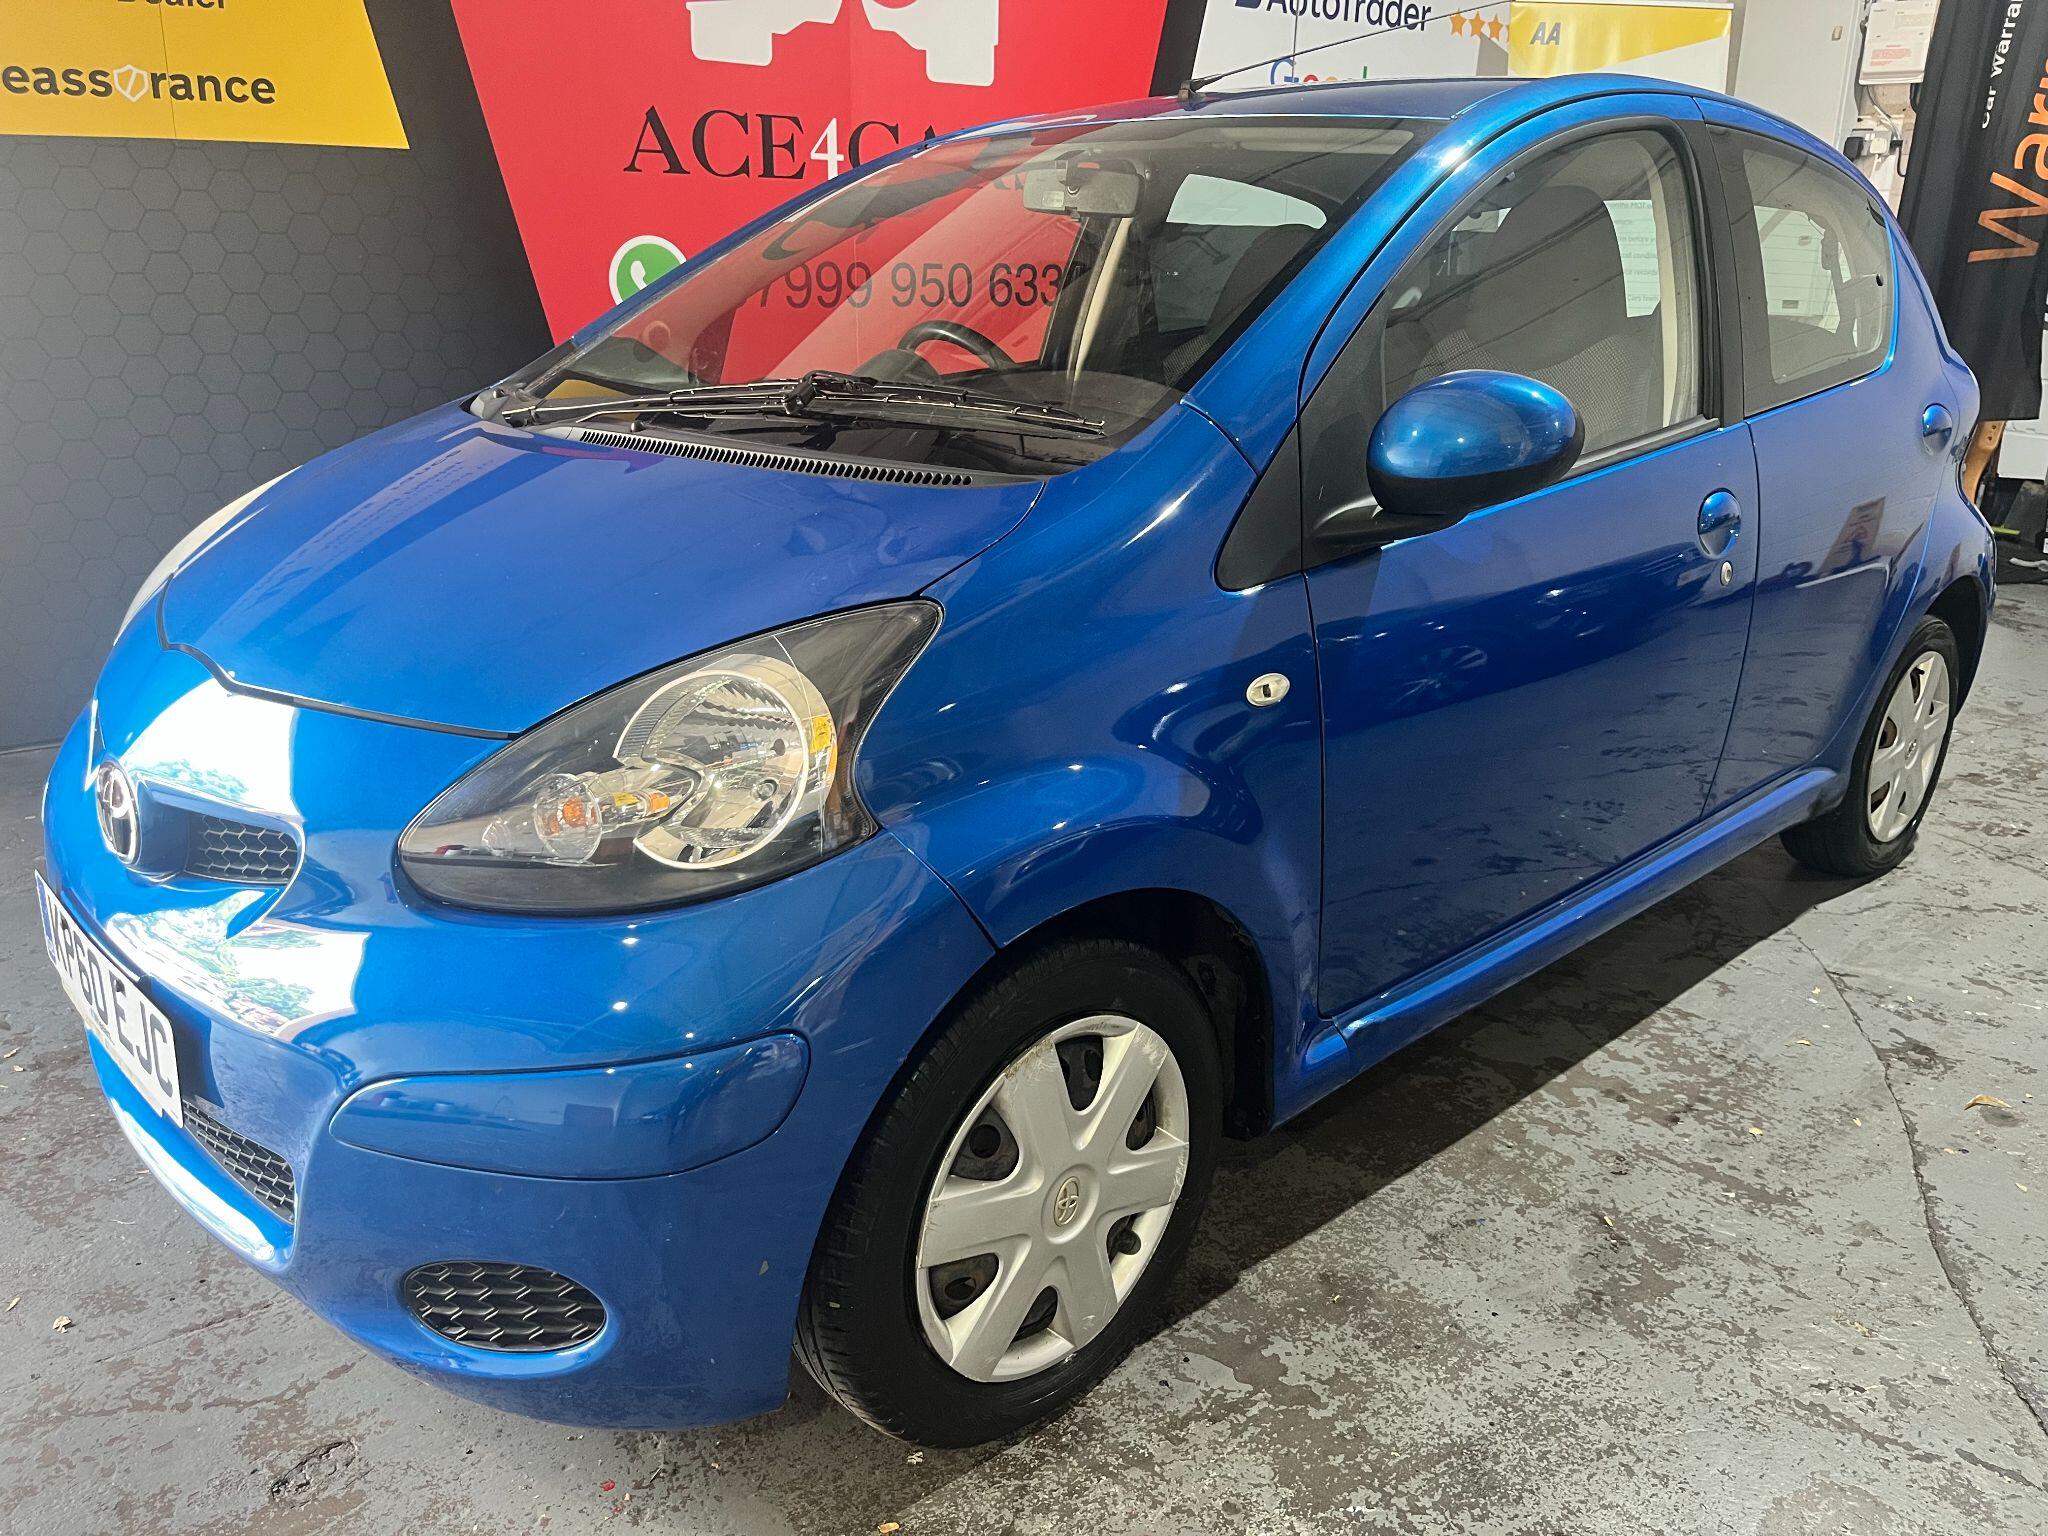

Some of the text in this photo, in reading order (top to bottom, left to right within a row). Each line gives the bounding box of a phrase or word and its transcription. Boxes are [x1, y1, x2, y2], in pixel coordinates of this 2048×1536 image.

[1530, 21, 1561, 46] AA
[1990, 0, 2024, 78] warra
[623, 105, 938, 180] ACE4C
[1967, 56, 2048, 263] War
[891, 262, 973, 309] 950
[989, 262, 1064, 308] 633
[108, 969, 174, 1099] EJC
